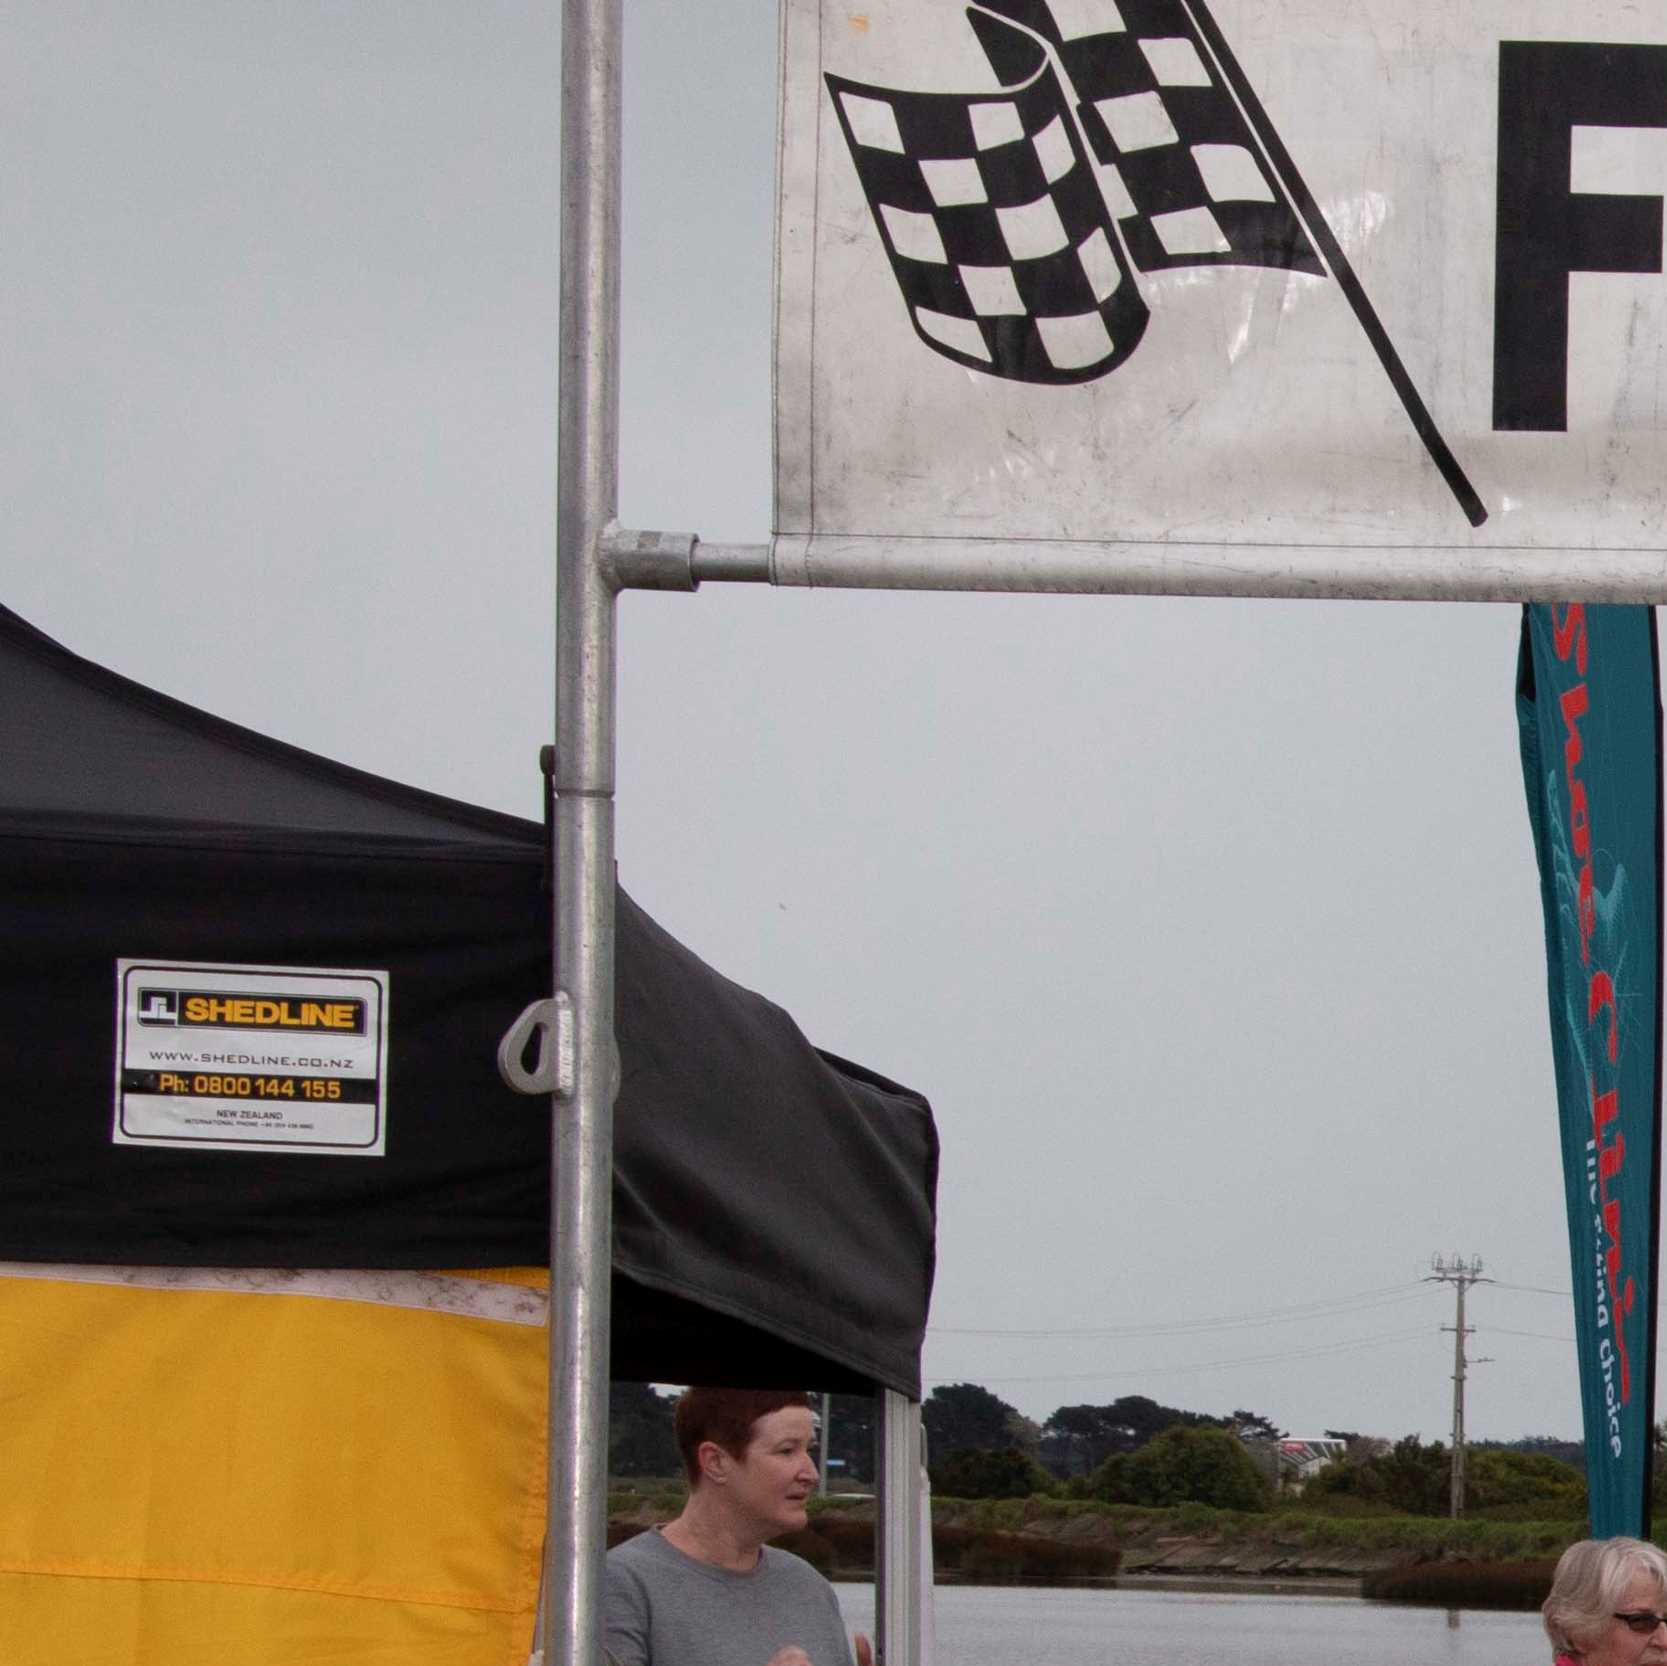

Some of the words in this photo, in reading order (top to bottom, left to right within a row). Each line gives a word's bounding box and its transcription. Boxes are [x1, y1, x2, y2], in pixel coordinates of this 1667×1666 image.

[184, 997, 355, 1027] SHEDLINE
[149, 1050, 354, 1069] WWW.SHEDLINE.CO.NZ
[158, 1072, 190, 1093] Ph:
[193, 1075, 250, 1095] 0800
[254, 1078, 295, 1097] 144
[301, 1080, 341, 1099] 155
[216, 1109, 238, 1118] NEW
[239, 1110, 284, 1120] ZEALAND
